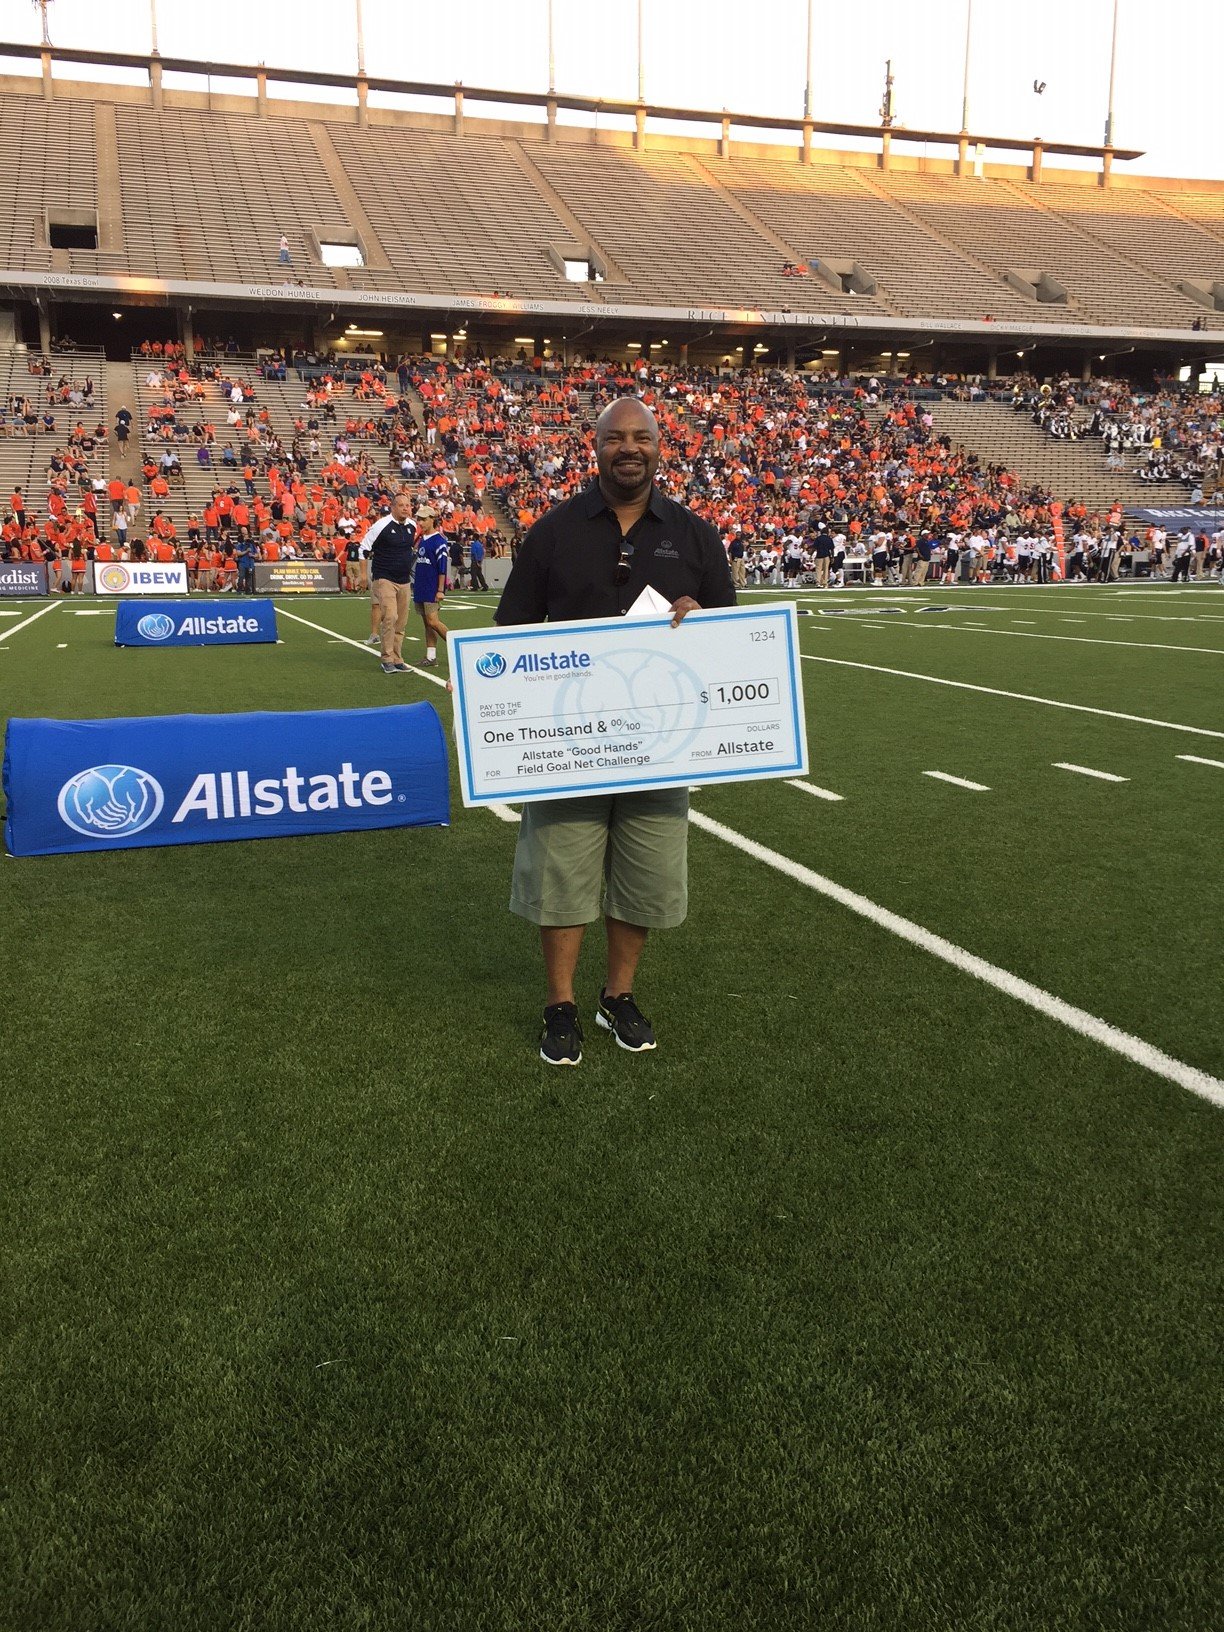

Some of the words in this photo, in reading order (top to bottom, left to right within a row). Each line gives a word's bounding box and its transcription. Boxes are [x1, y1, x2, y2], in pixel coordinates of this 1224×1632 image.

[43, 276, 60, 284] 2008
[62, 277, 81, 285] Texas
[82, 278, 99, 286] Bowl
[249, 288, 284, 297] WELDON
[287, 290, 320, 299] HUMBLE
[358, 294, 380, 302] JOHN
[381, 296, 416, 304] HEISMAN
[452, 300, 475, 308] JAMES
[478, 300, 506, 309] FROGGY
[512, 302, 544, 310] WILLIAMS
[577, 305, 596, 313] JESS
[597, 306, 619, 314] NEELY
[687, 310, 726, 321] RICE
[133, 572, 181, 584] IBEW
[177, 615, 259, 636] Allstate
[749, 630, 775, 642] 1234
[512, 650, 591, 674] Allstate
[523, 673, 545, 682] You're
[553, 671, 571, 681] good
[700, 690, 709, 704] $
[717, 683, 769, 704] 1,000
[507, 701, 522, 709] THE
[480, 710, 505, 718] ORDER
[483, 731, 514, 744] One
[518, 721, 593, 740] Thousand
[597, 720, 608, 733] &
[747, 723, 780, 733] DOLLARS
[522, 748, 564, 761] Allstate
[691, 750, 712, 758] FROM
[717, 740, 774, 755] Allstate
[517, 764, 543, 775] Field
[546, 761, 571, 773] Goal
[574, 760, 594, 770] Net
[596, 754, 651, 768] Challenge
[485, 769, 501, 778] FOR
[171, 762, 393, 823] Allstate
